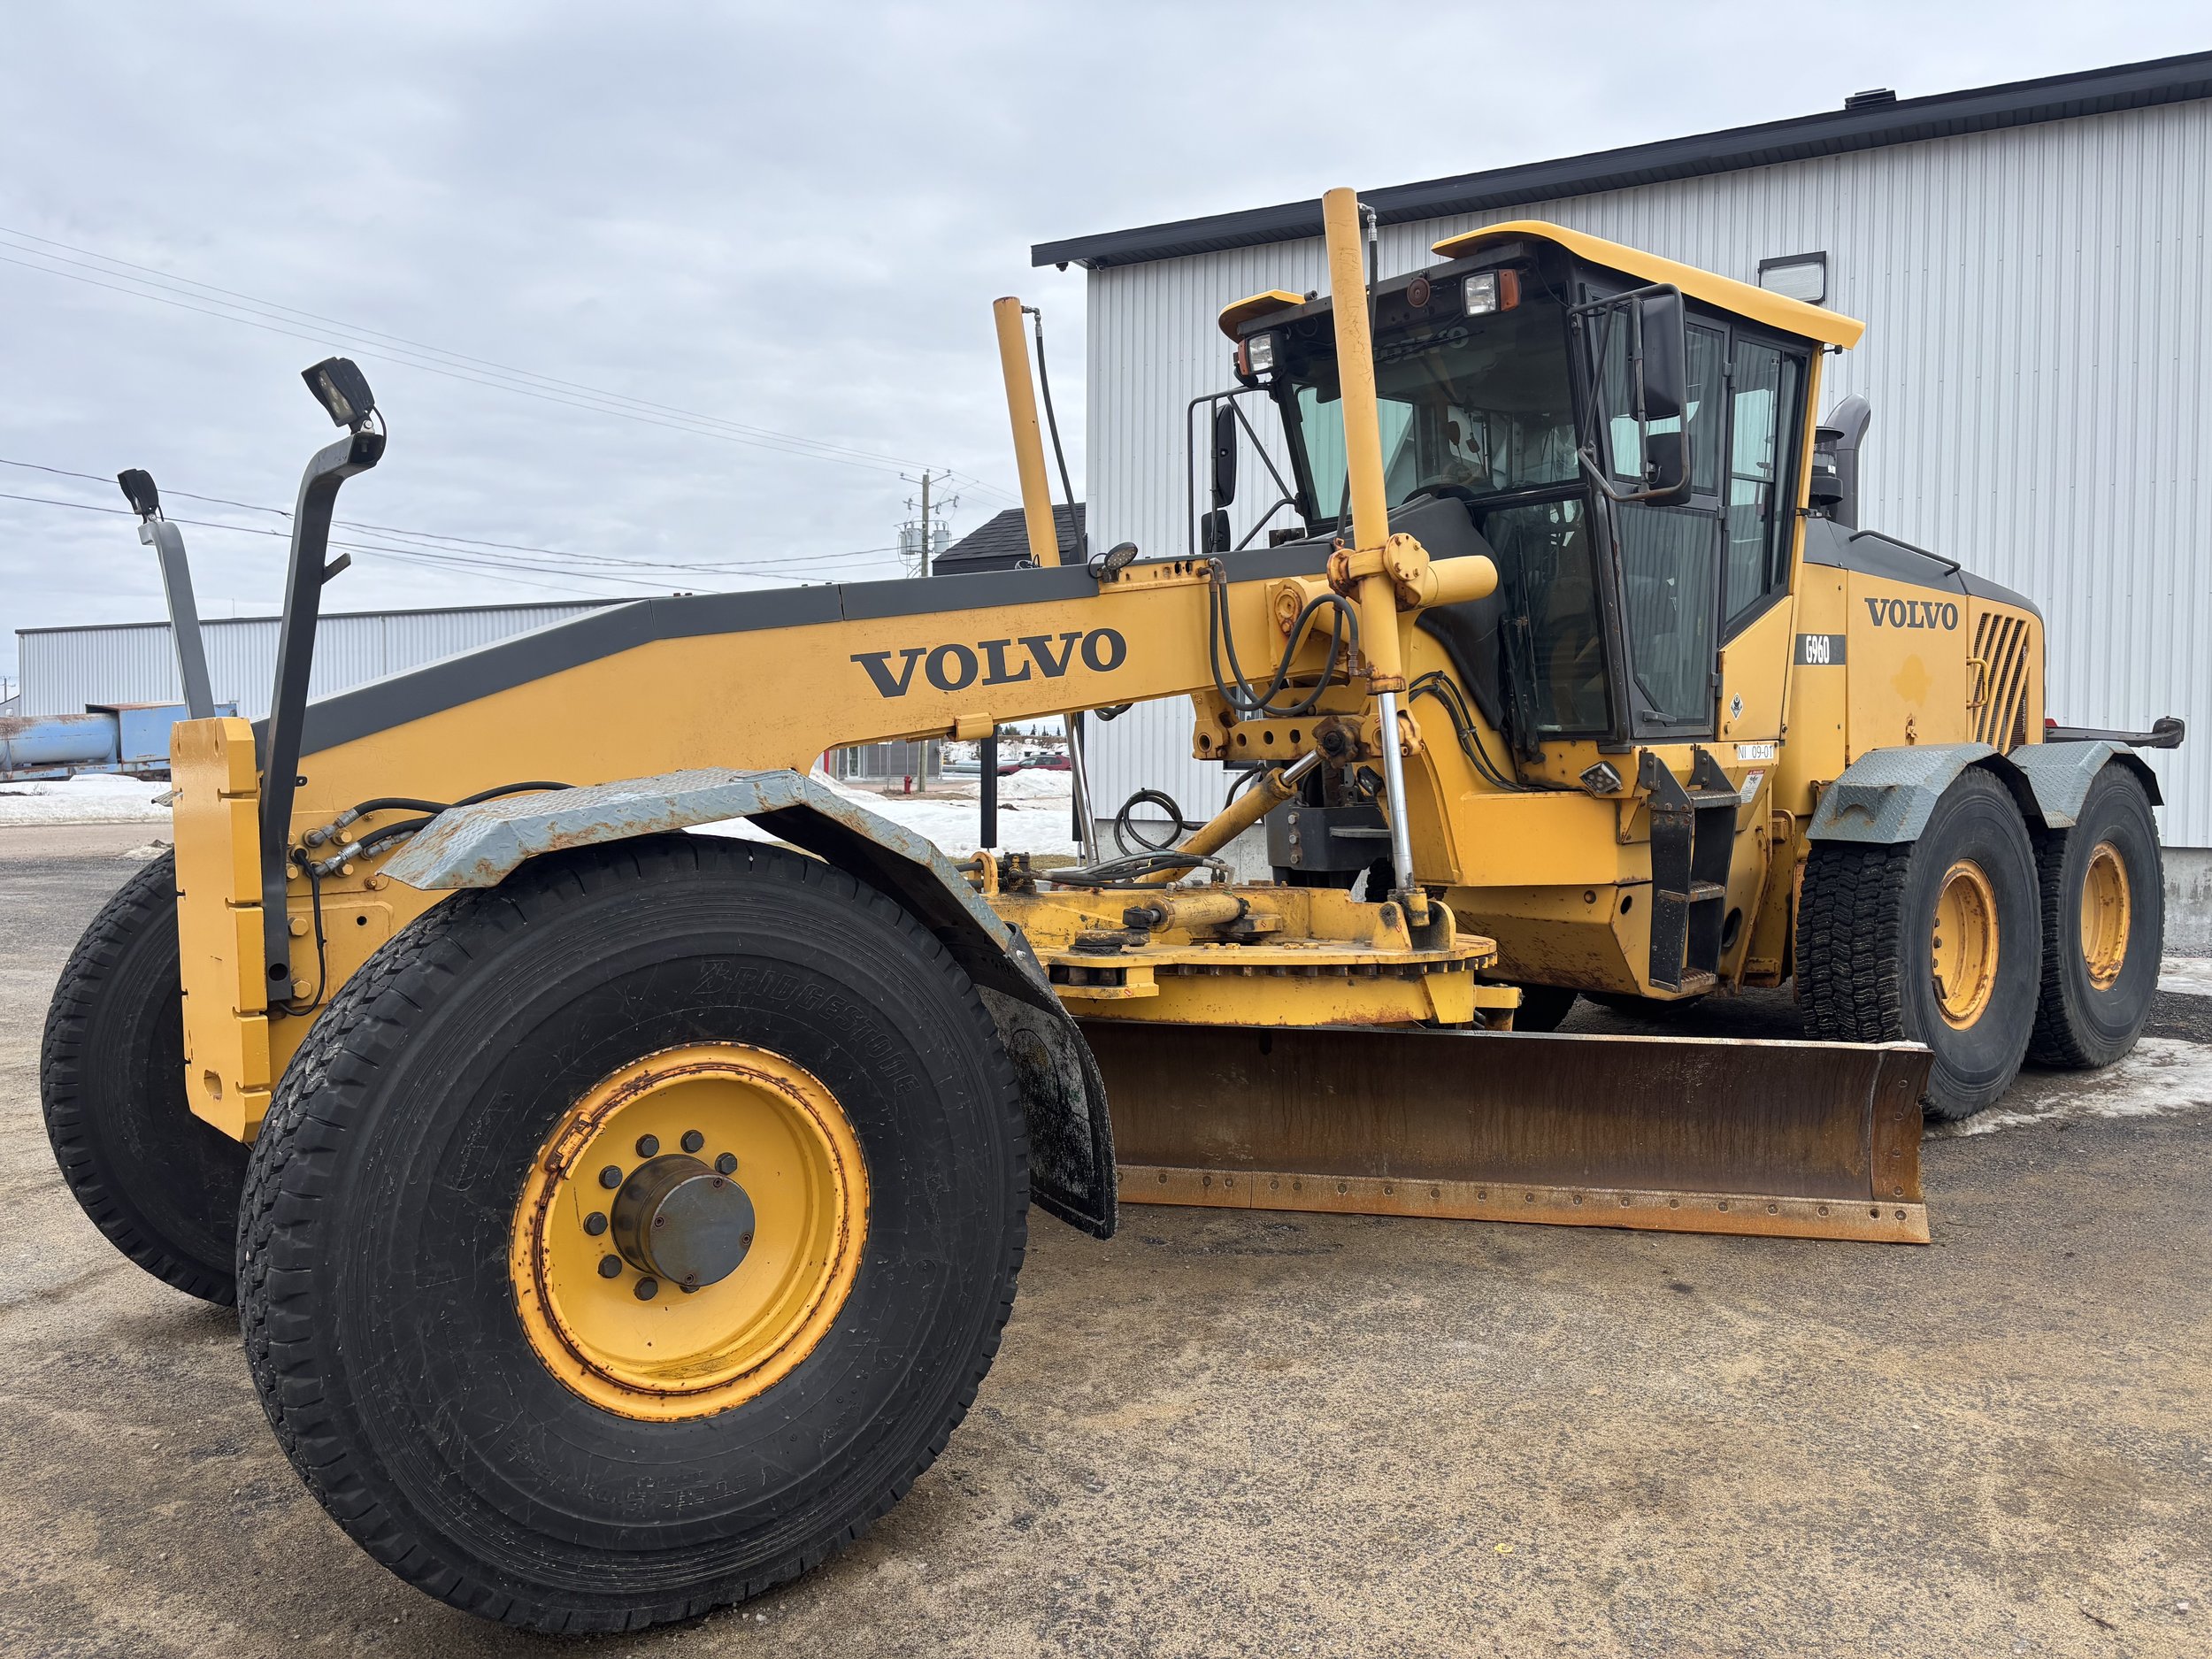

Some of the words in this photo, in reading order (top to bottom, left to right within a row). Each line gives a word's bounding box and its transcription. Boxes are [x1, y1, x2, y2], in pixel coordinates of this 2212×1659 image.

[1864, 597, 1959, 631] VOLVO
[850, 626, 1128, 698] VOLVO
[1805, 634, 1831, 664] G960
[1752, 746, 1773, 759] 09-01
[690, 958, 922, 1097] BRIDGESTONE
